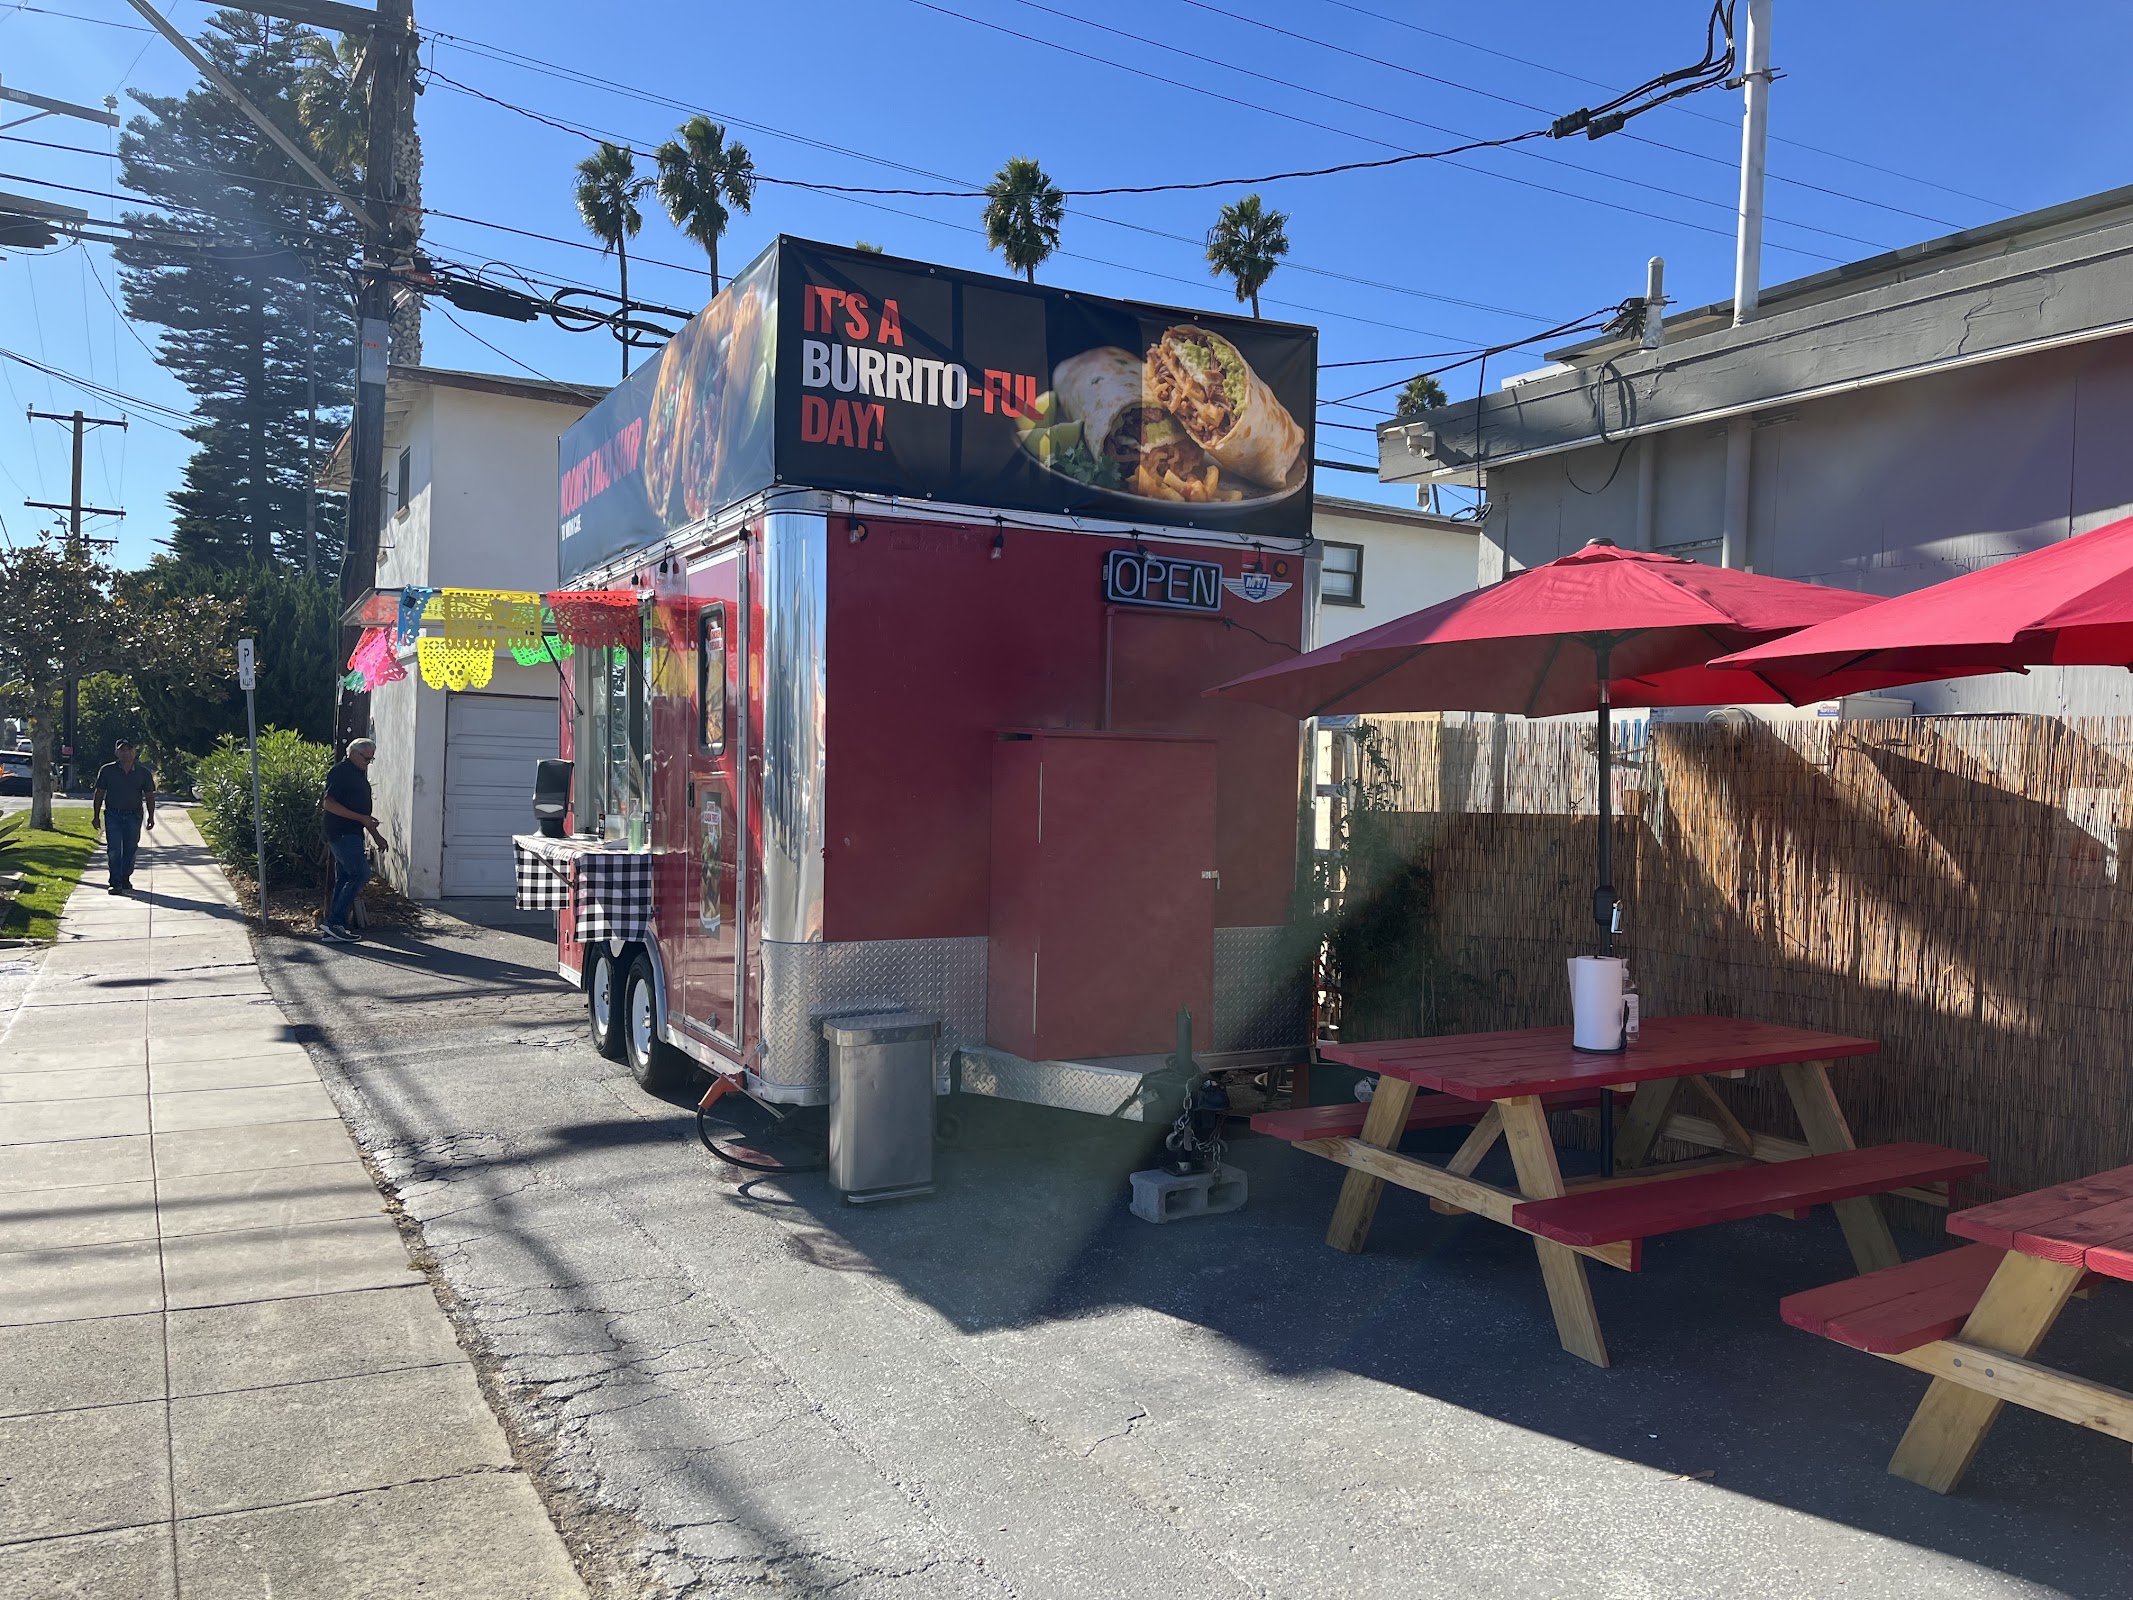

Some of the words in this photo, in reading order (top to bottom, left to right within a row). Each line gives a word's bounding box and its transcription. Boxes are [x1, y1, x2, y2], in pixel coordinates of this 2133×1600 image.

[803, 284, 870, 341] IT'S
[877, 298, 904, 348] A
[802, 338, 1045, 421] BURRITO-FUL
[801, 393, 886, 452] DAY!
[591, 439, 613, 498] TACO
[613, 416, 643, 483] SHOP
[1115, 558, 1216, 605] OPEN
